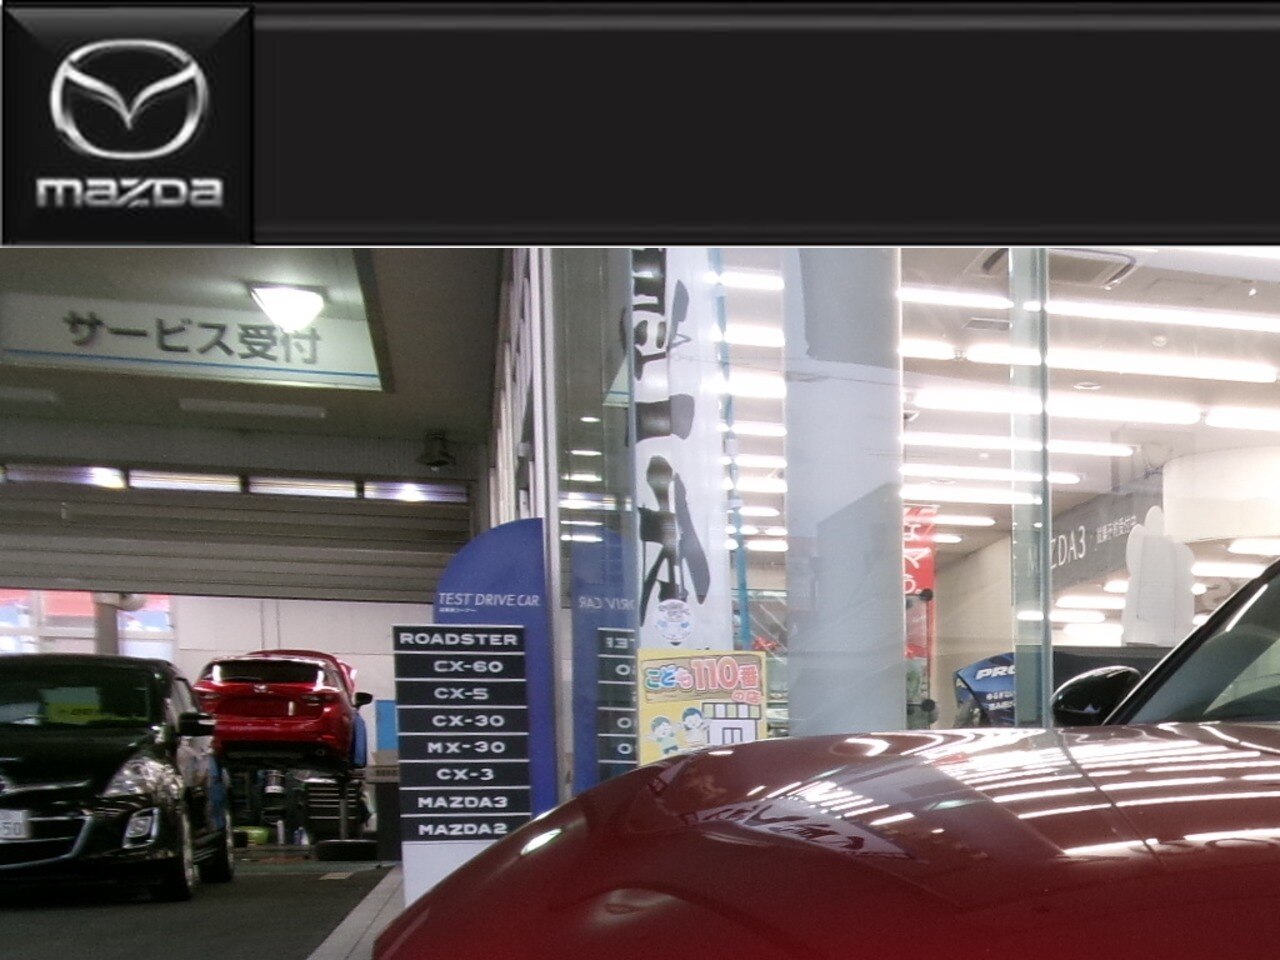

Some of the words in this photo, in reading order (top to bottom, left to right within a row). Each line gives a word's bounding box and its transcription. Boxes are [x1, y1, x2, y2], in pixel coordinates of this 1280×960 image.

[63, 308, 321, 366] サービス受付
[438, 592, 473, 606] TEST
[475, 593, 515, 607] DRIVE
[517, 594, 539, 607] CAR
[400, 632, 518, 646] ROADSTER
[433, 660, 504, 673] CX-60
[645, 656, 760, 691] こども110番
[433, 687, 489, 700] CX-5
[431, 715, 505, 727] CX-30
[427, 741, 506, 753] MX-30
[436, 768, 495, 781] CX-3
[417, 796, 508, 808] MAZDA3
[418, 823, 508, 835] MAZDA2
